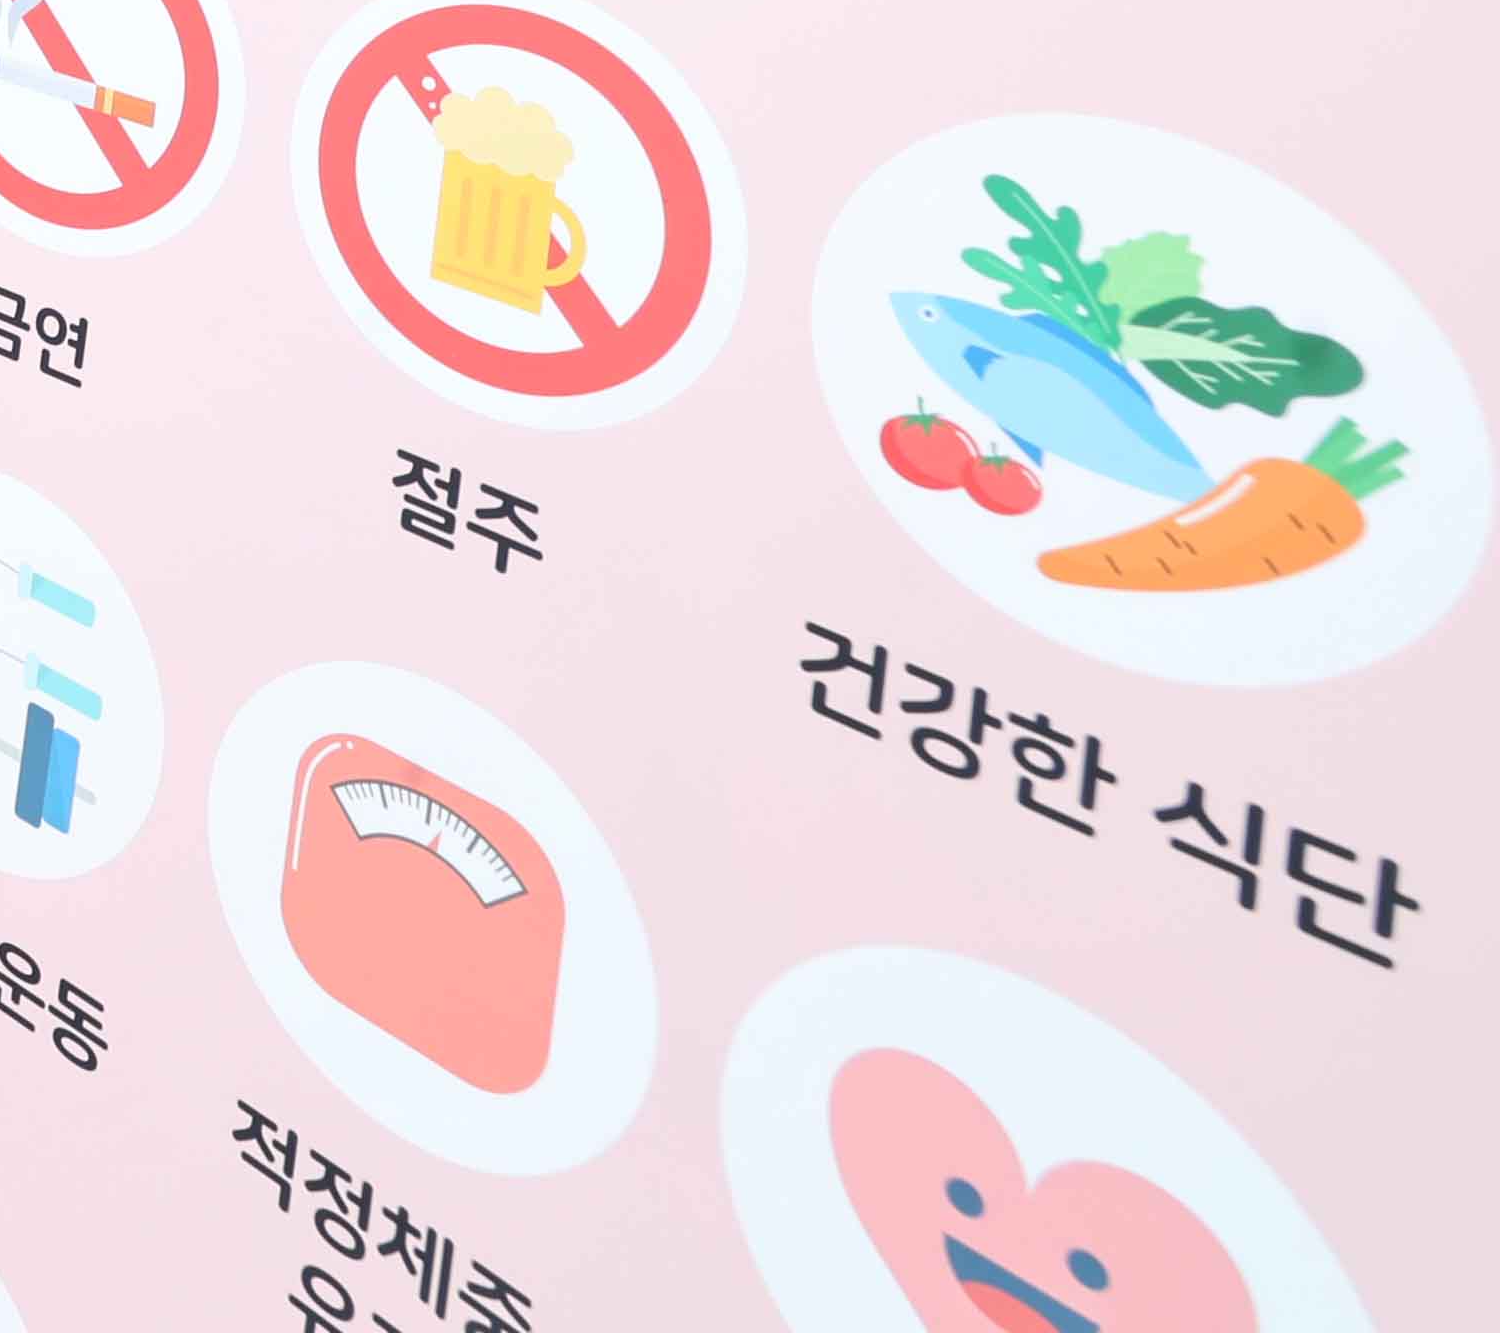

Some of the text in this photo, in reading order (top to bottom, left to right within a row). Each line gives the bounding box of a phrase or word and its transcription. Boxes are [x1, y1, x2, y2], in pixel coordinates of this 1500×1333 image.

[391, 448, 544, 574] 절주
[798, 620, 1422, 971] 건강한 식단
[231, 1098, 533, 1333] 적정체중
[288, 1264, 405, 1333] 유
